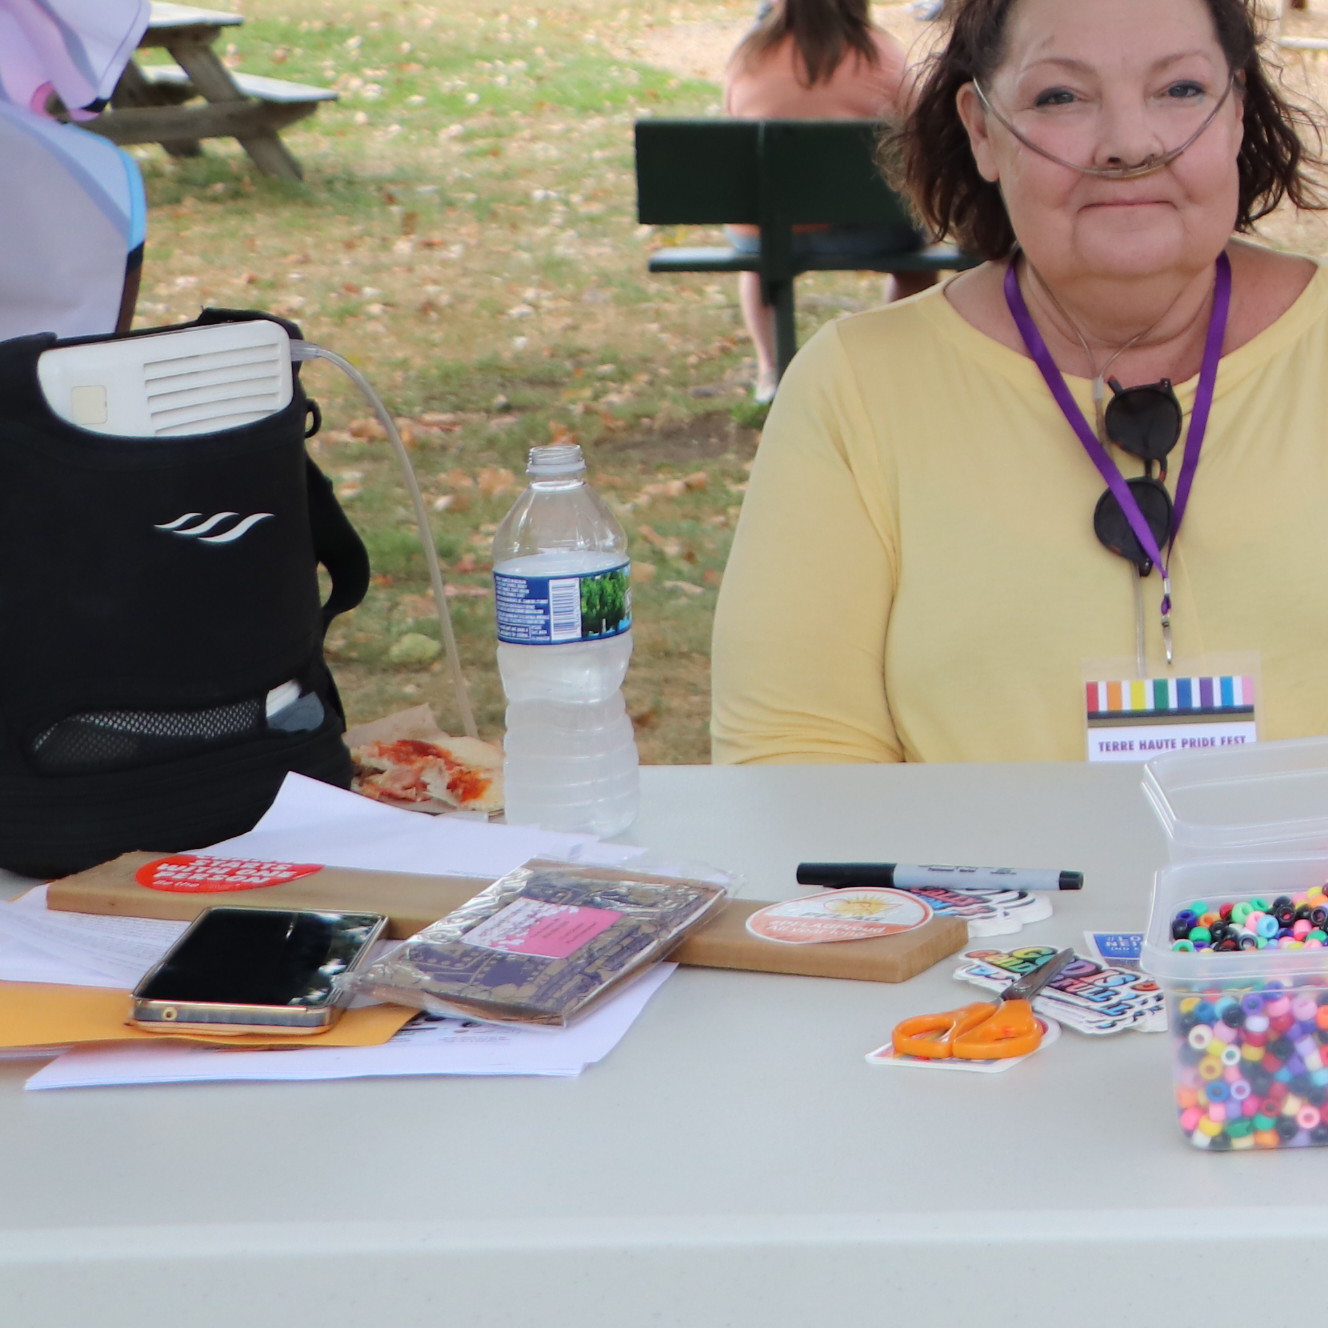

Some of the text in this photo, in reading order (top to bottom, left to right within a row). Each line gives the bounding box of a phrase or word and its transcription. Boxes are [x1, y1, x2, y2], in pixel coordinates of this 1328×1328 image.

[1098, 735, 1246, 752] TERRE HAUTE PRIDE FEST
[156, 863, 298, 878] WITH ONE
[190, 859, 294, 870] STARTS
[153, 871, 272, 884] PERSON
